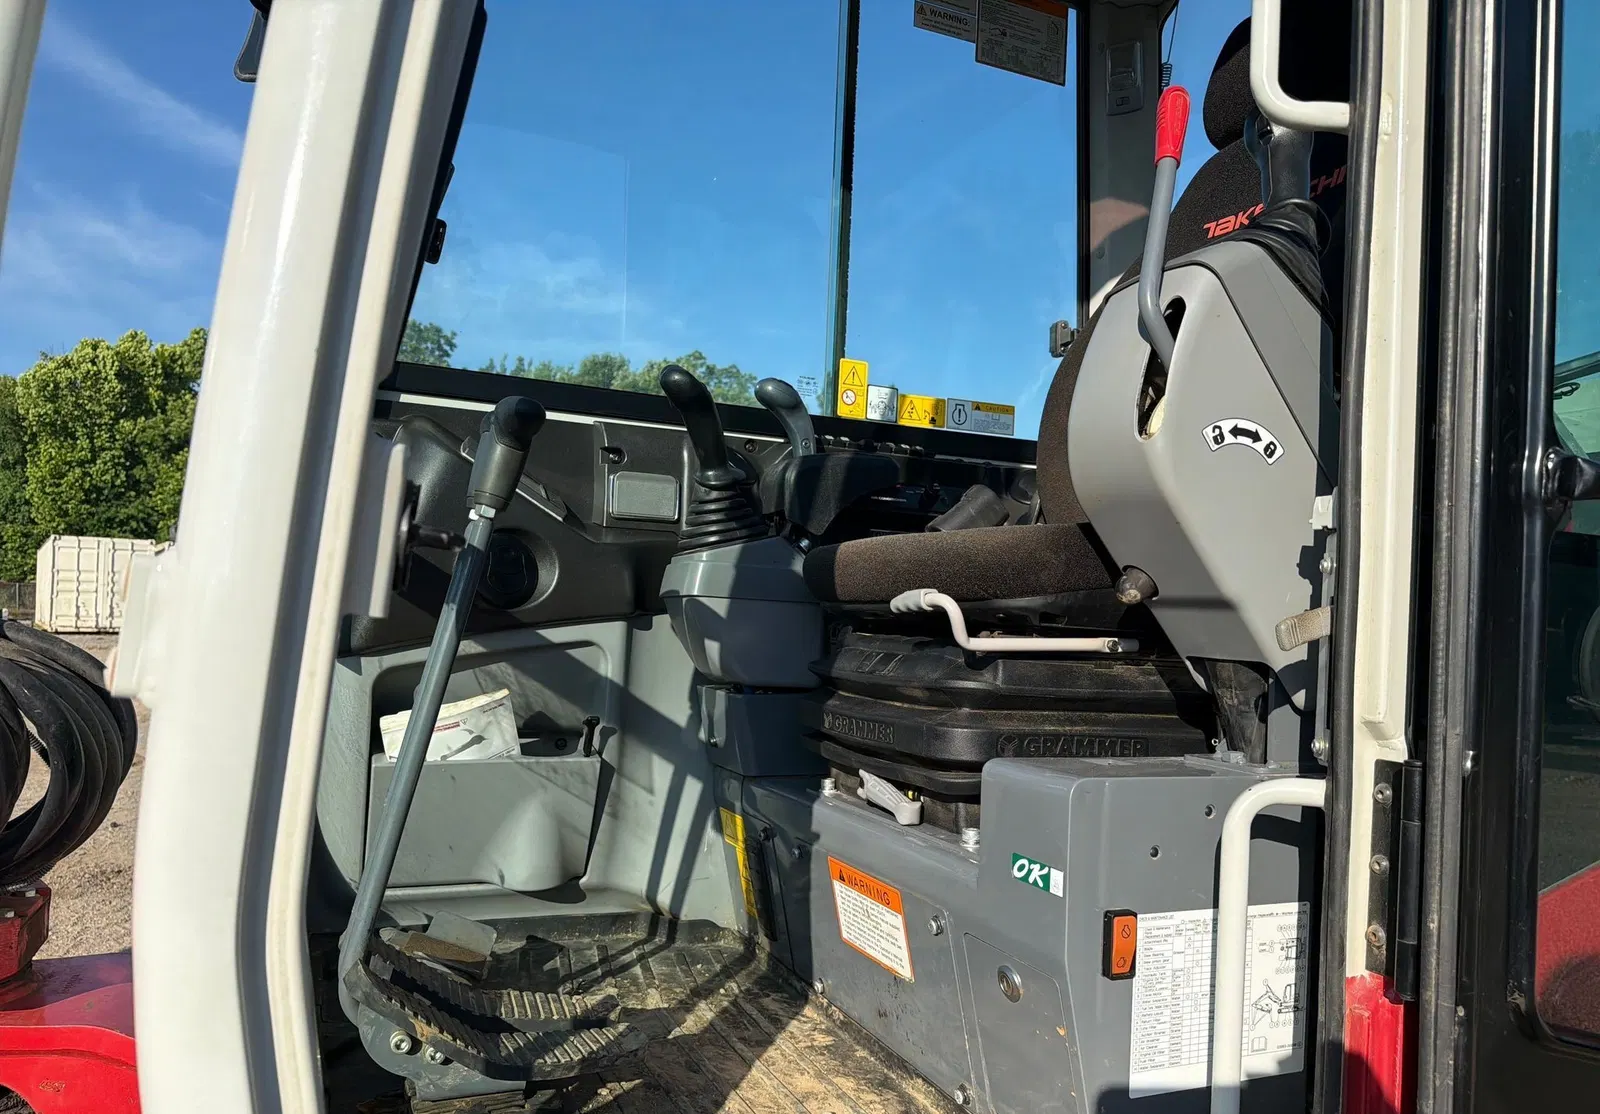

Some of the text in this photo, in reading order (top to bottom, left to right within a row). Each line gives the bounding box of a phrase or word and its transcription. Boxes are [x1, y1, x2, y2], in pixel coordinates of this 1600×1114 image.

[929, 8, 970, 26] WARNING:
[834, 714, 894, 743] GRAMMER
[1024, 736, 1149, 757] GRAMMER
[1013, 858, 1049, 888] OK
[846, 873, 891, 906] WARNING
